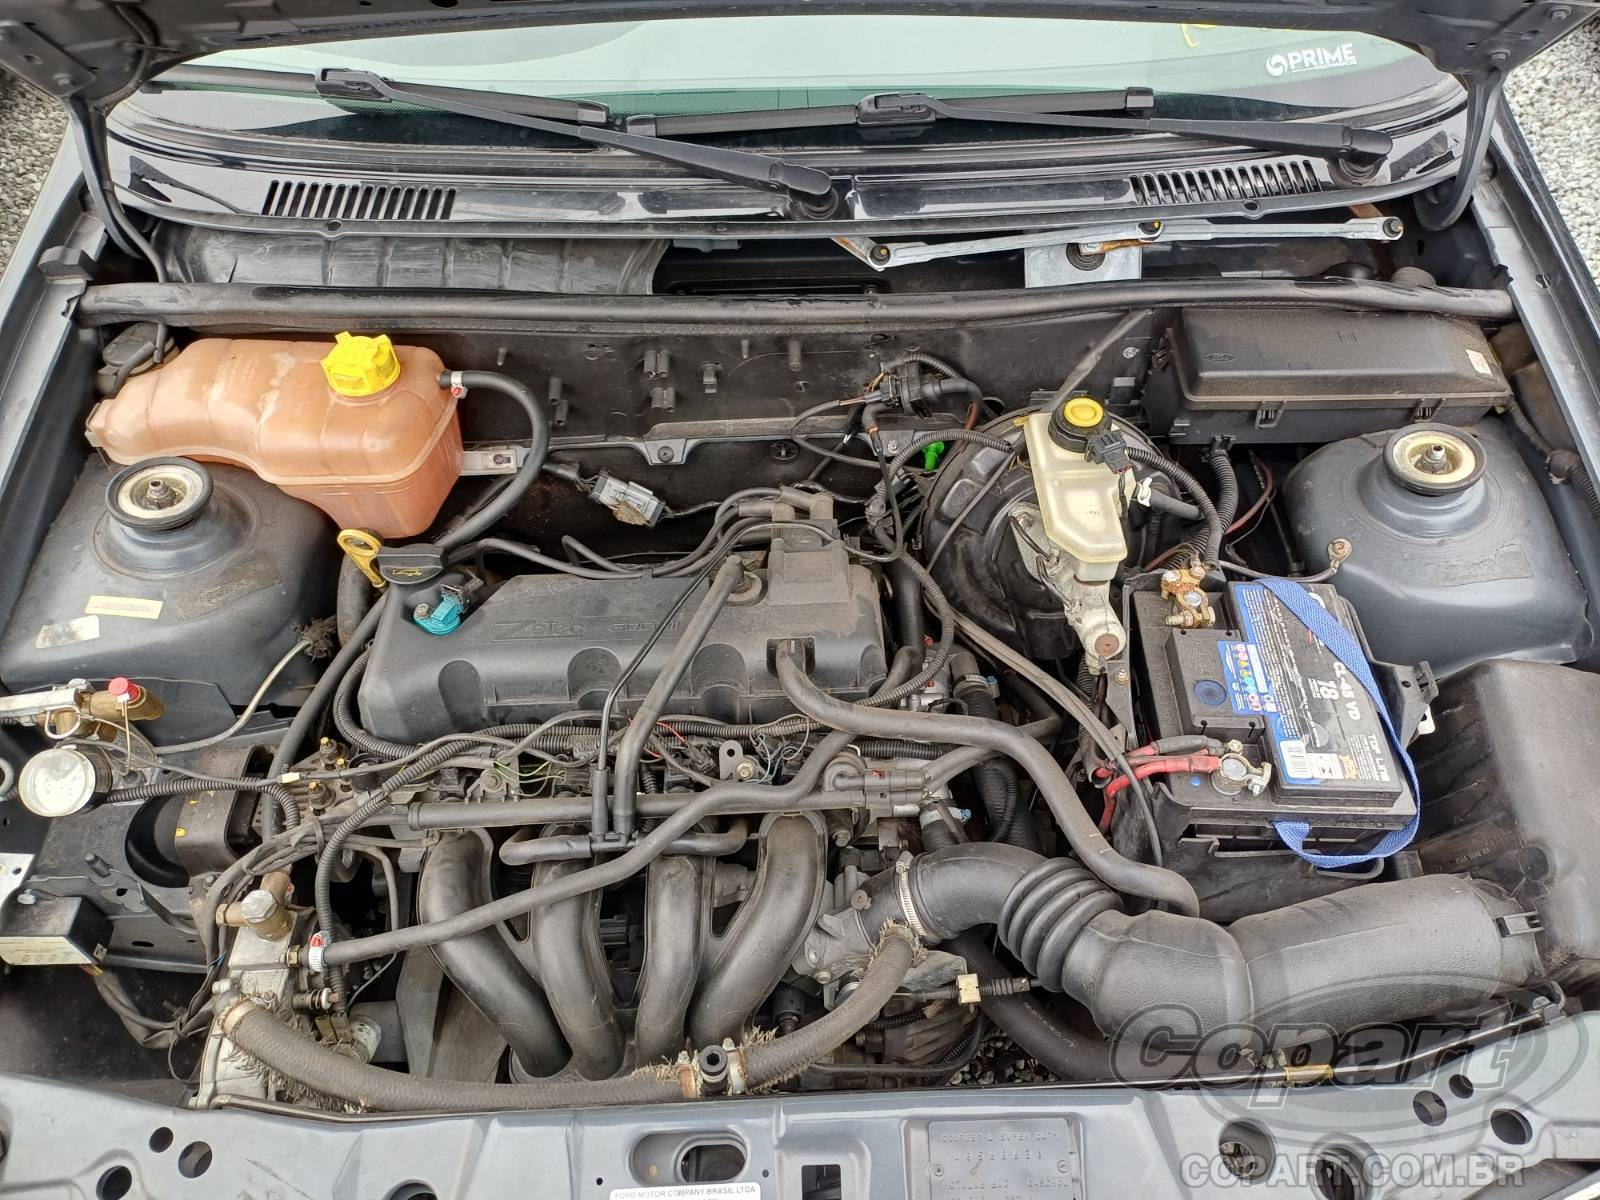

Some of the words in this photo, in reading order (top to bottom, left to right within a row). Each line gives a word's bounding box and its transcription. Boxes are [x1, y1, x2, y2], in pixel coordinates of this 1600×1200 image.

[1287, 43, 1355, 69] PRIME
[1317, 680, 1339, 700] 18
[637, 1190, 665, 1198] MOTOR
[667, 1188, 704, 1197] COMPANY
[706, 1186, 734, 1195] BRASIL
[736, 1185, 756, 1193] LTDA
